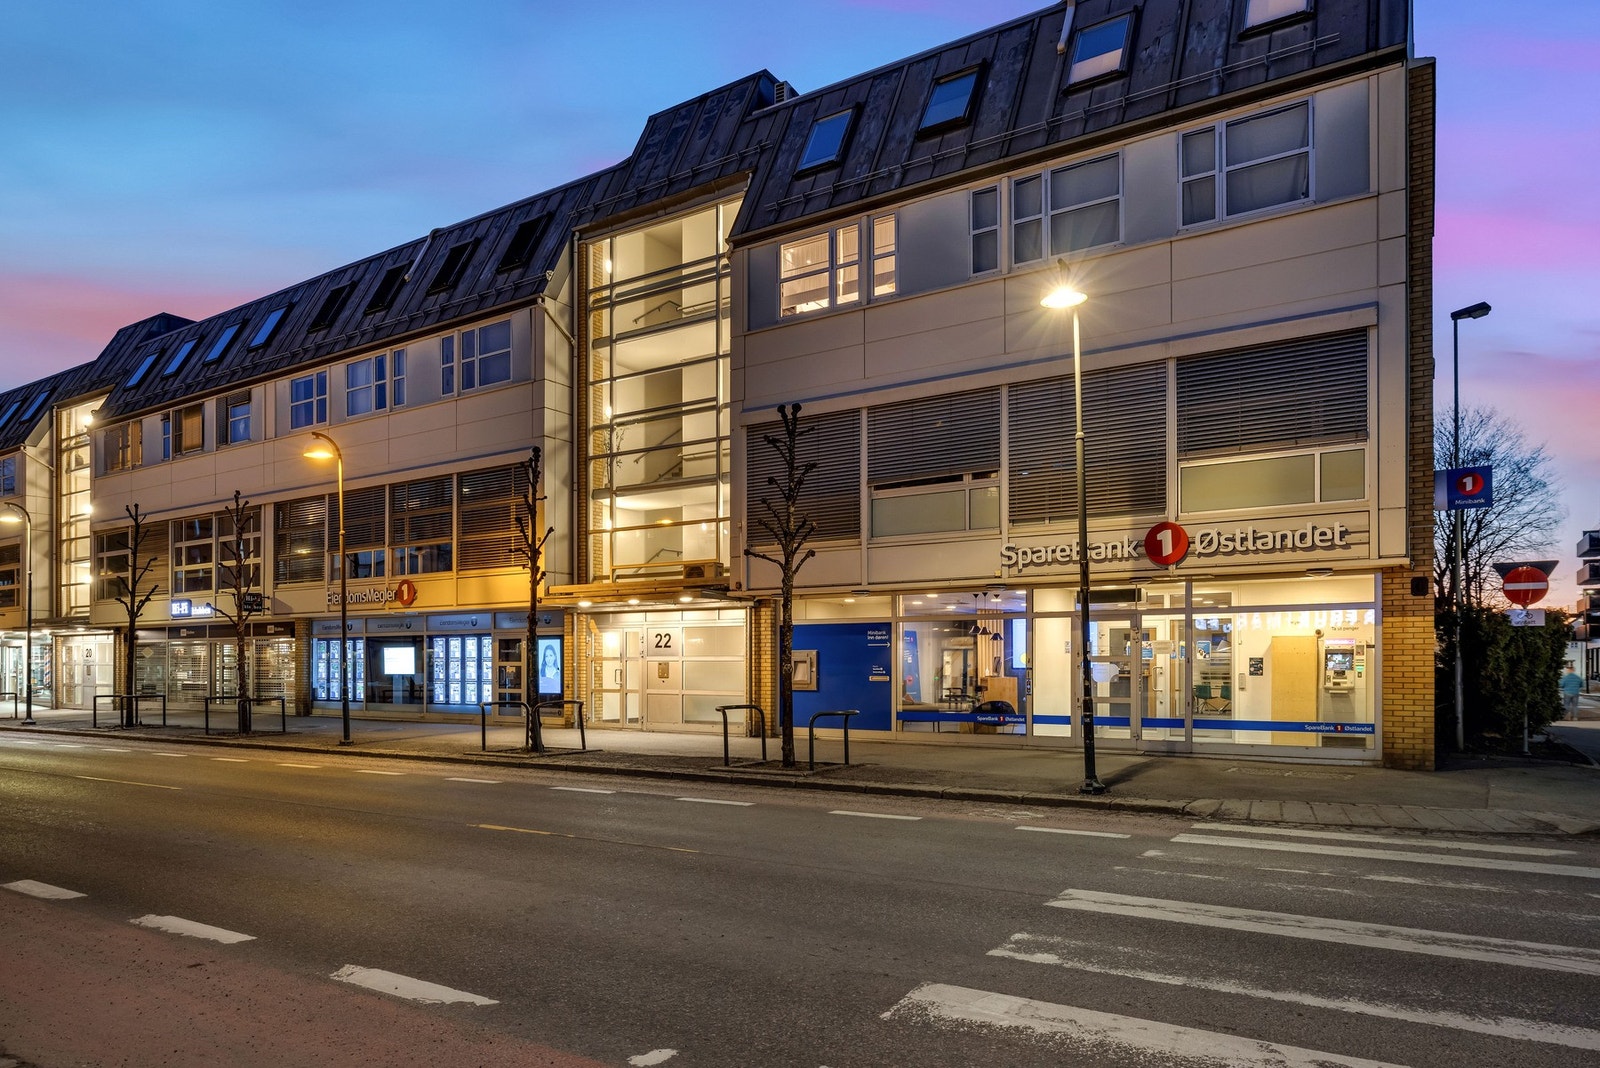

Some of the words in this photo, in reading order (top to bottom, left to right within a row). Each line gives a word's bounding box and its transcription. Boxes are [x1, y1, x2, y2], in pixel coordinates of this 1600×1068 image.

[1462, 476, 1473, 491] 1
[1156, 529, 1173, 557] 1
[1194, 522, 1347, 555] Østlandet
[655, 633, 671, 648] 22
[85, 648, 93, 658] 20
